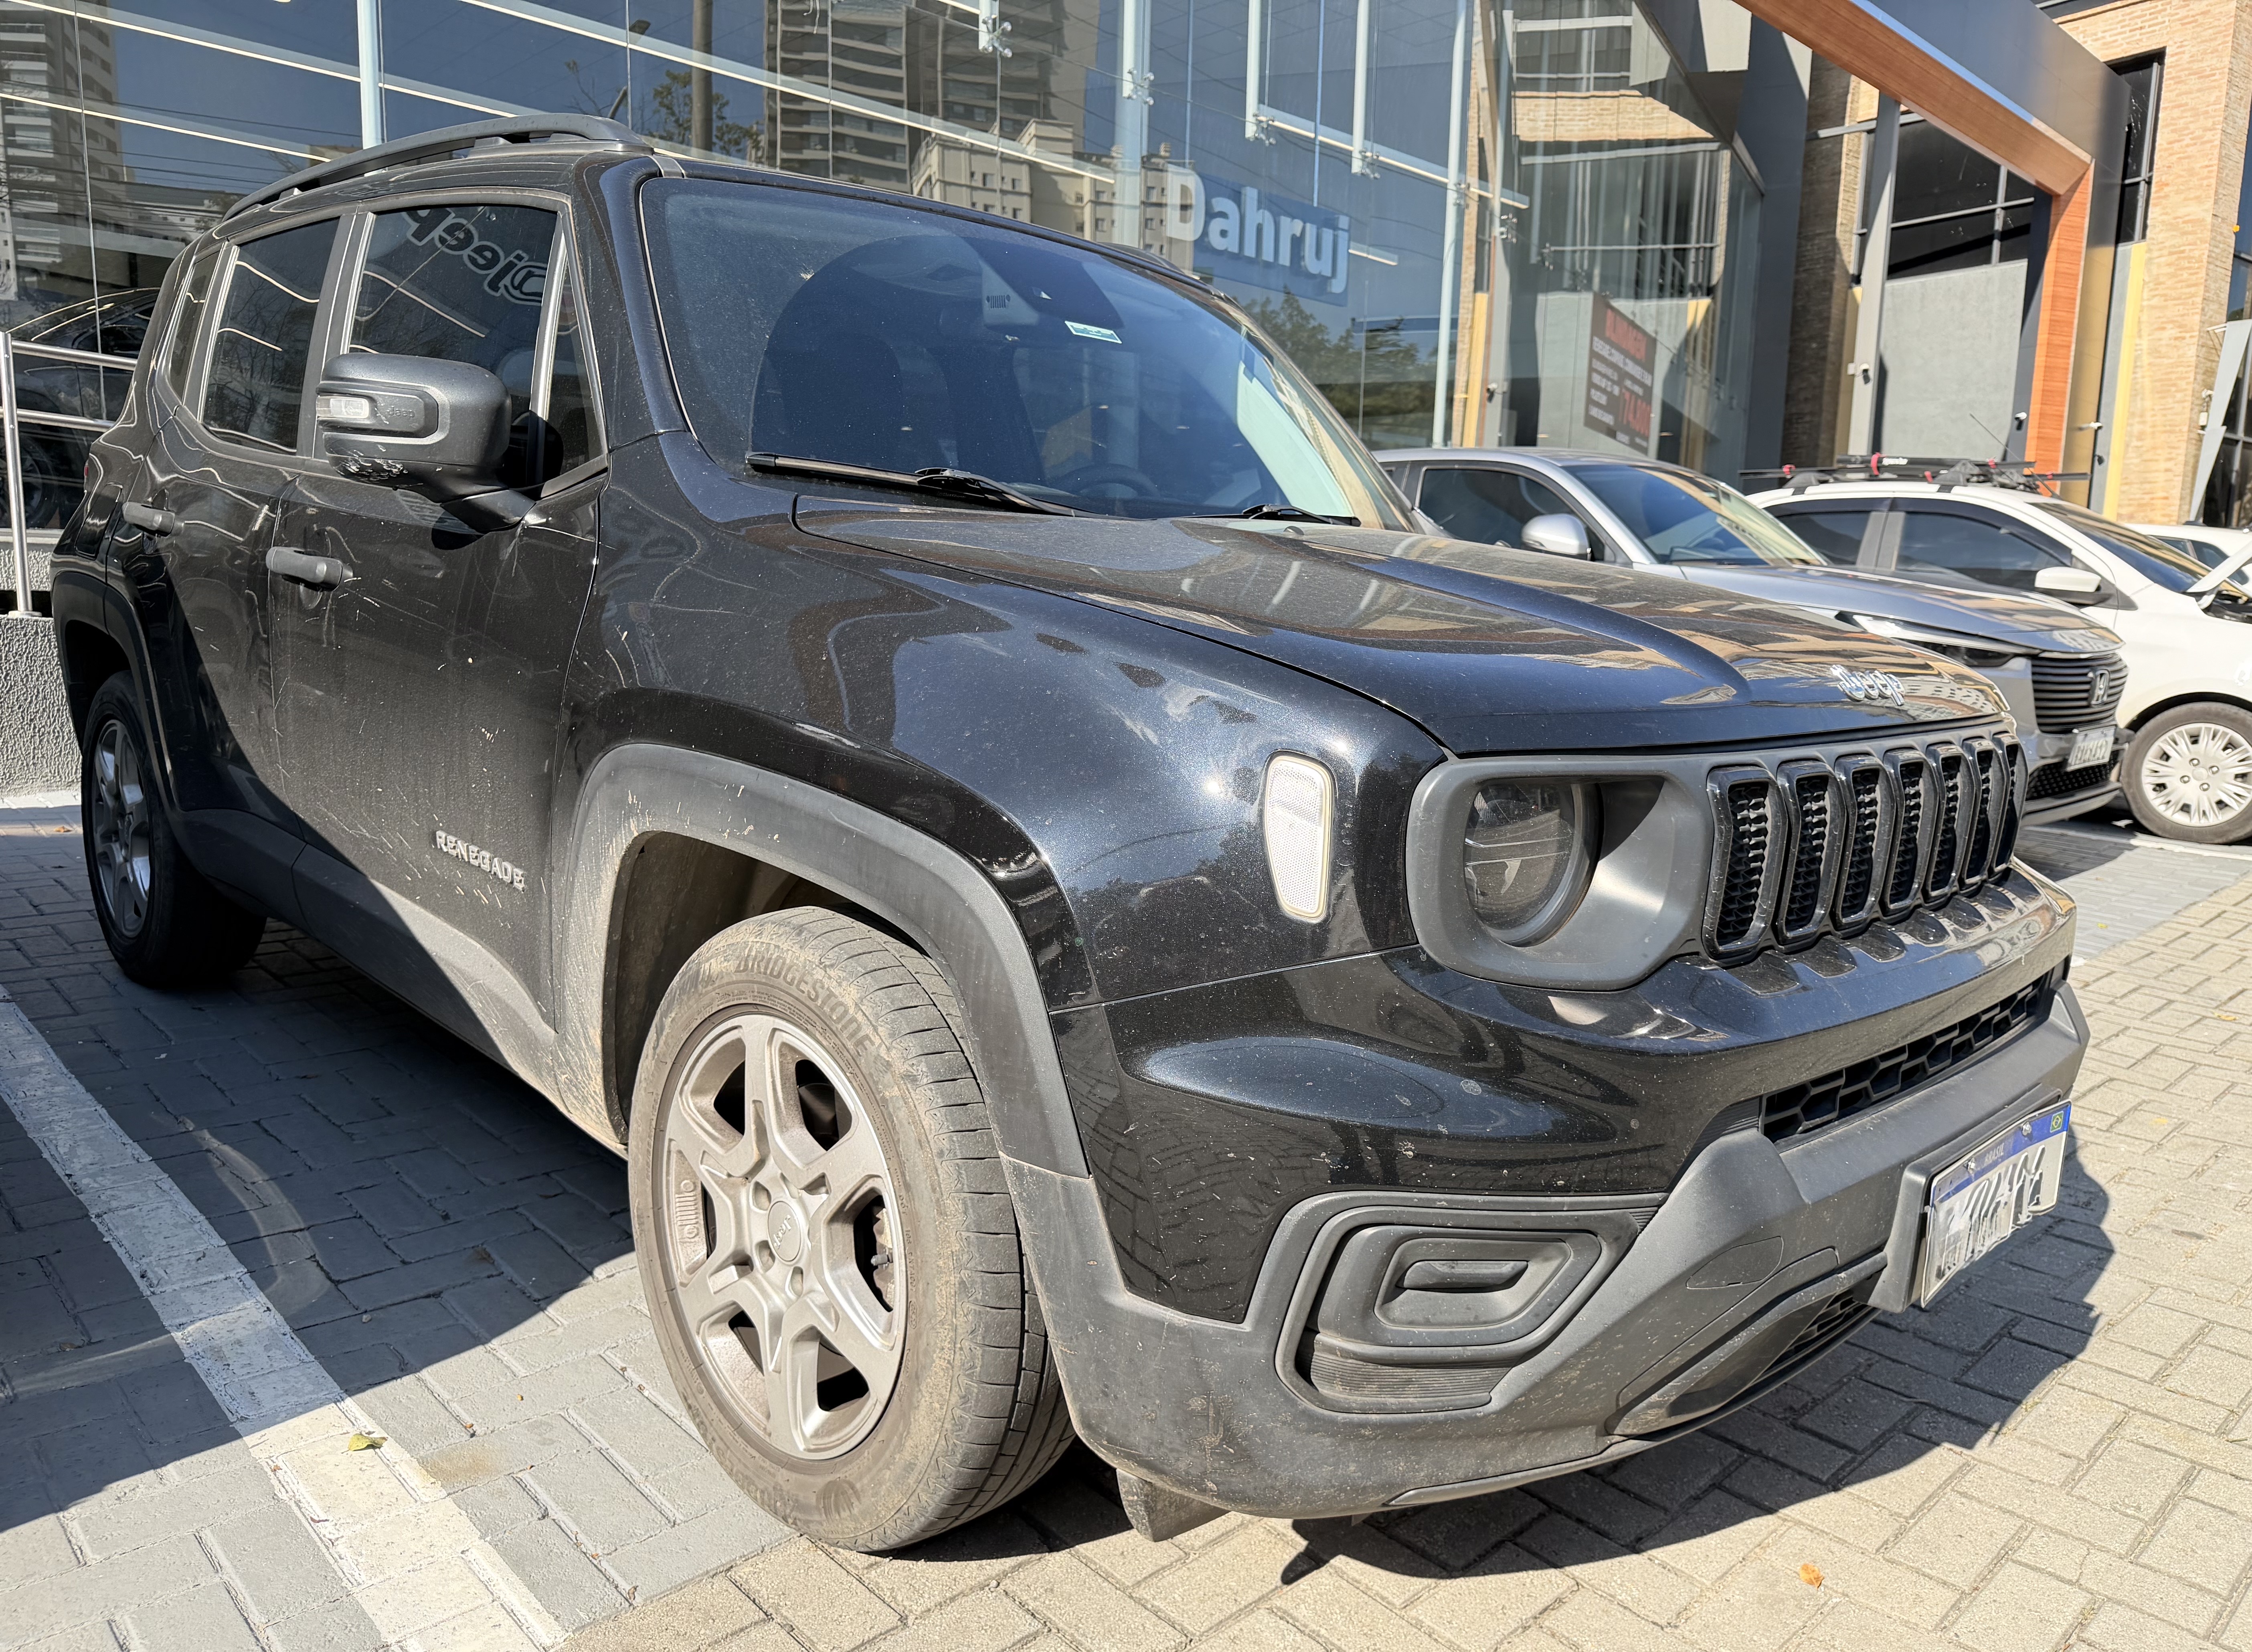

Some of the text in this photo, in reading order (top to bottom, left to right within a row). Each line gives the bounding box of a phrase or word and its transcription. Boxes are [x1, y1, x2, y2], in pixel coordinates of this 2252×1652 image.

[1166, 164, 1350, 293] Dahruj
[388, 406, 415, 419] Jeep
[1829, 664, 1905, 706] Jeep
[436, 830, 525, 892] RENEGADE
[734, 949, 876, 1058] BRIDGESTONE
[1984, 1142, 2005, 1167] BRASIL
[774, 1214, 791, 1250] Jeep
